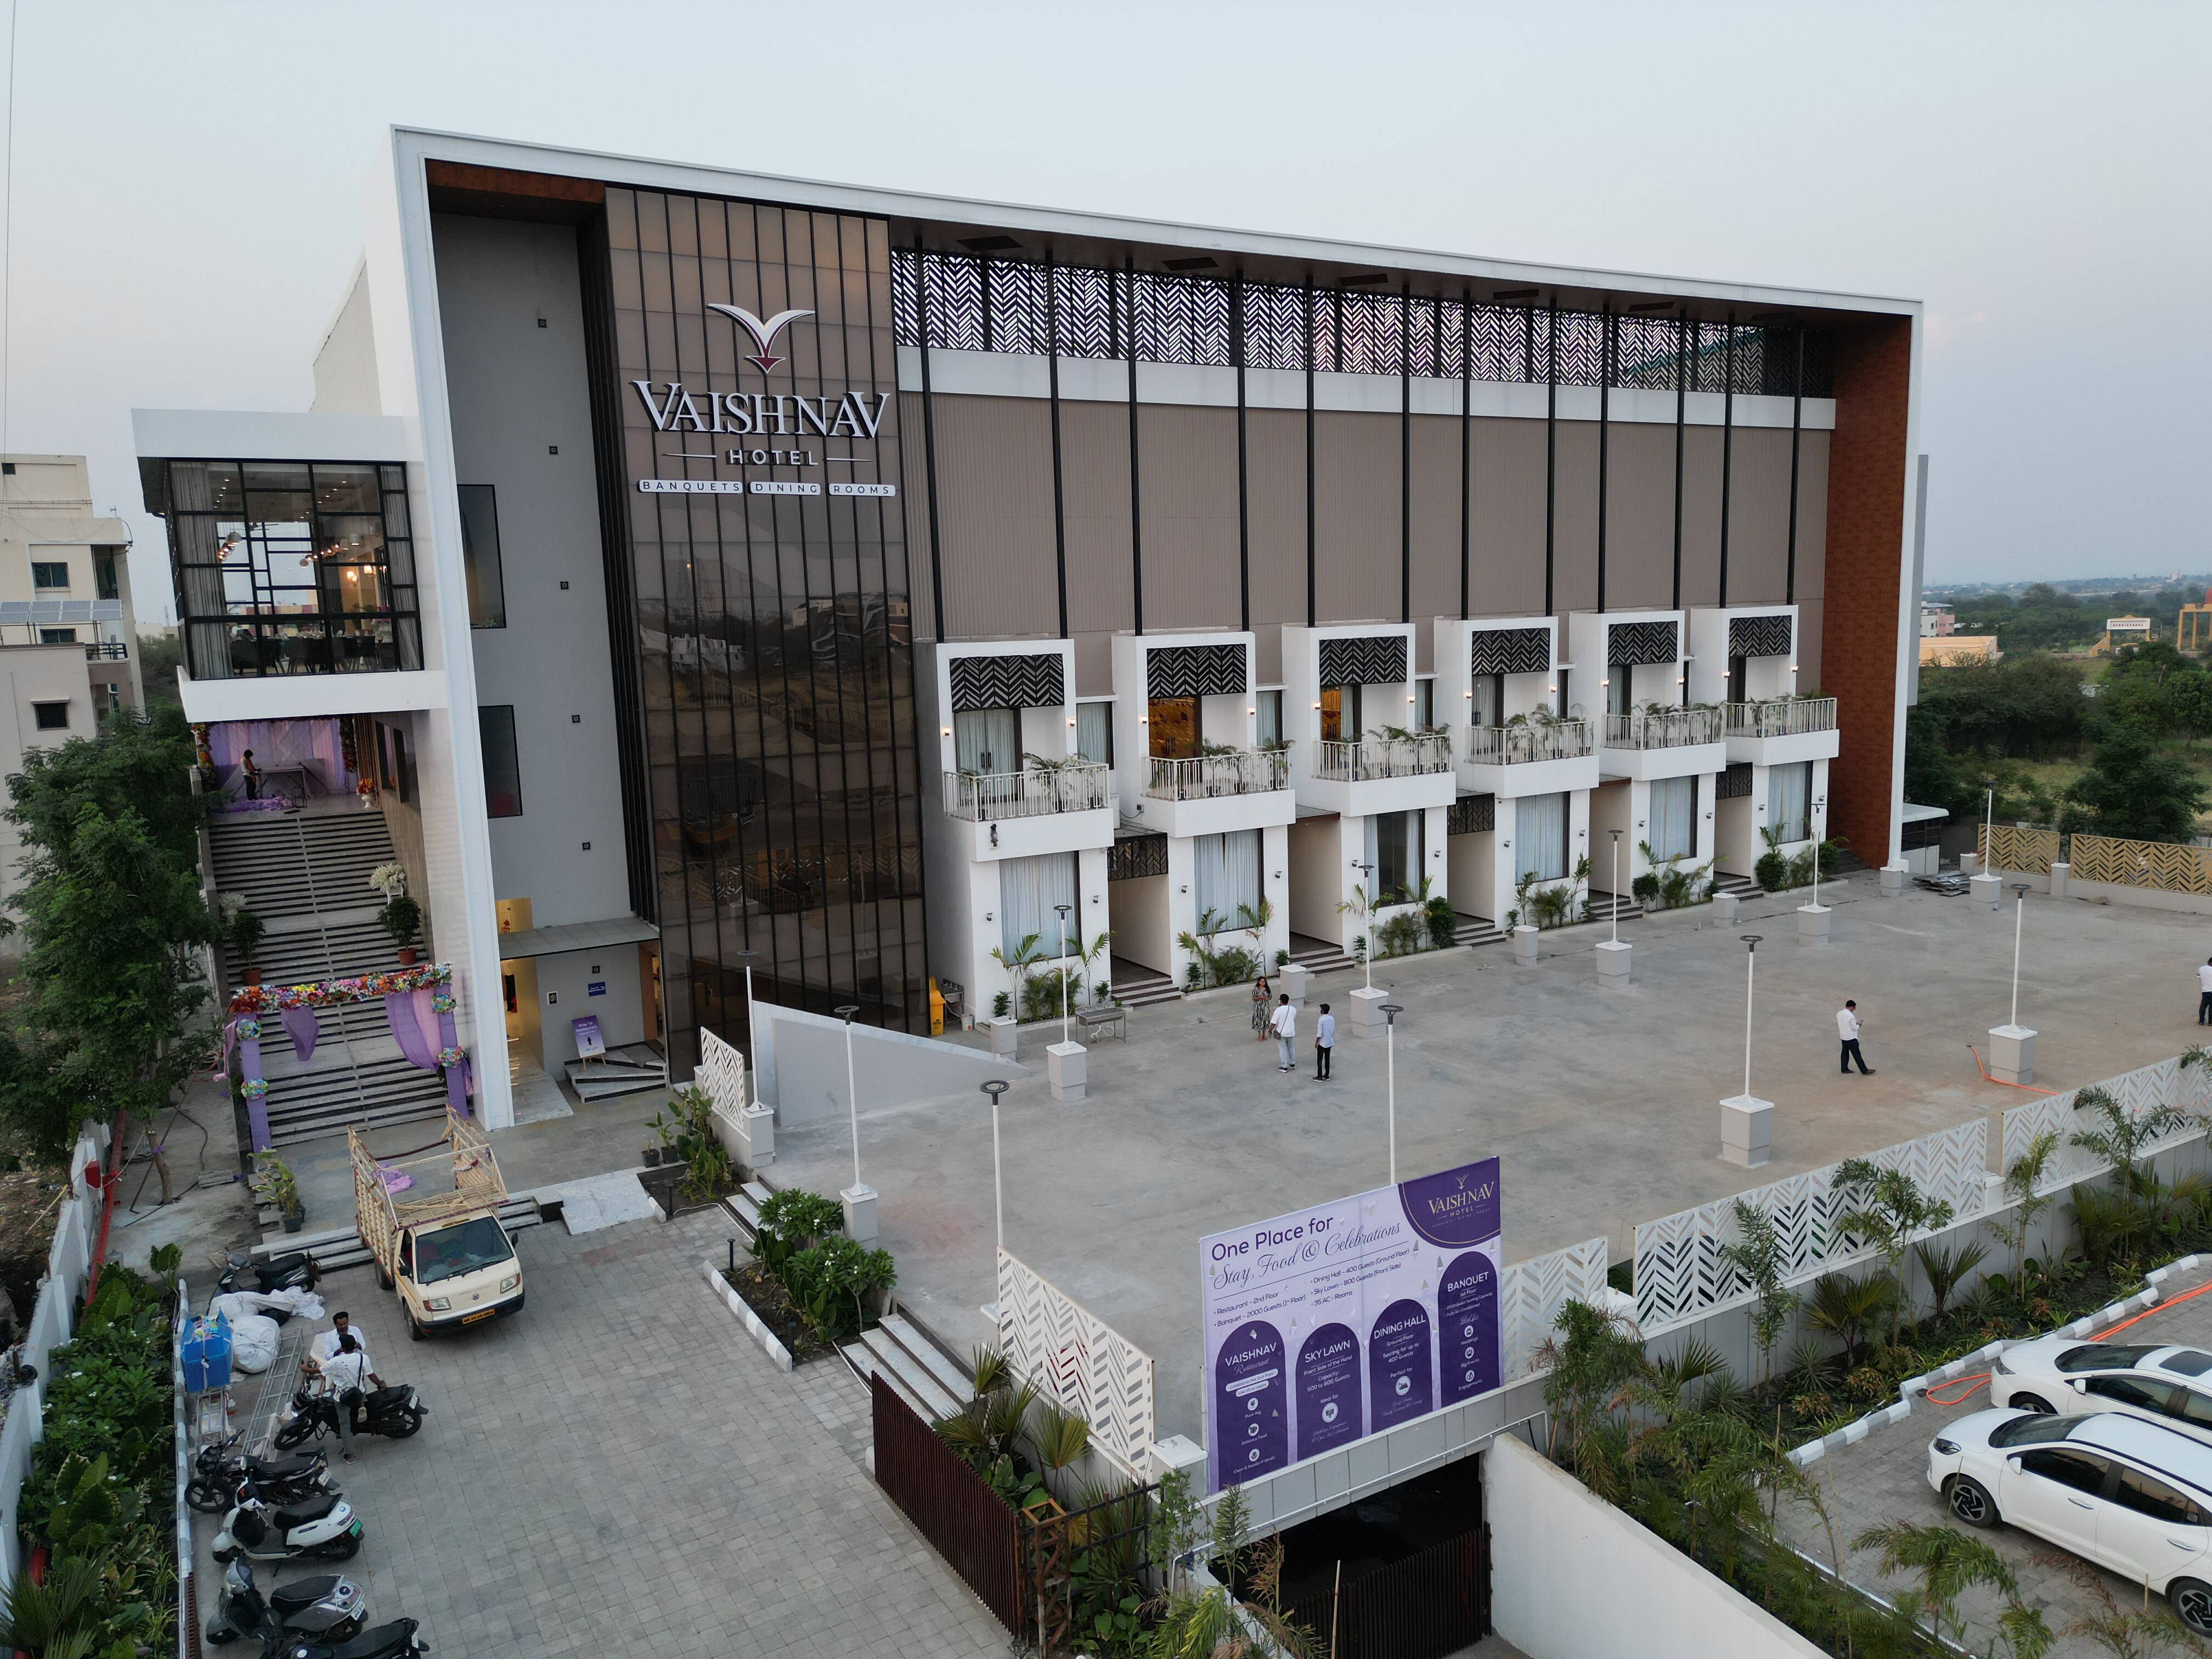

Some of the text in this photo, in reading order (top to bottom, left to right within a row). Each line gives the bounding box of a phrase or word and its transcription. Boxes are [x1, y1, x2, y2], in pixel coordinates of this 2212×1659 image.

[632, 380, 891, 438] VAISHNAV
[729, 449, 818, 465] HOTEL
[642, 482, 889, 494] BANQUETS DINING ROOMS
[1427, 1181, 1494, 1215] VAISHNAV
[1450, 1206, 1474, 1217] HOTEL
[1211, 1217, 1334, 1261] One Place for
[1214, 1264, 1255, 1289] Stay,
[1257, 1242, 1302, 1278] Food
[1325, 1223, 1401, 1256] Celebrations
[1314, 1274, 1330, 1284] Dining
[1331, 1270, 1341, 1278] Hall
[1346, 1265, 1357, 1274] 400
[1358, 1261, 1375, 1270] Guests
[1375, 1254, 1395, 1265] (Ground
[1396, 1248, 1409, 1258] Floor)
[1324, 1284, 1339, 1292] Lawn
[1356, 1272, 1373, 1282] Guests
[1374, 1267, 1389, 1277] (Front
[1389, 1262, 1401, 1271] Side)
[1448, 1271, 1489, 1293] BANQUET
[1217, 1301, 1248, 1315] Restaurant
[1253, 1295, 1265, 1304] 2nd
[1265, 1292, 1279, 1300] Floor
[1322, 1296, 1330, 1304] AC
[1335, 1290, 1353, 1300] Rooms
[1217, 1314, 1242, 1327] Banquet
[1246, 1308, 1263, 1318] 2000
[1263, 1302, 1282, 1313] Guests
[1291, 1294, 1306, 1304] Floor)
[1374, 1314, 1426, 1340] DINING HALL
[1305, 1340, 1350, 1363] SKY LAWN
[1386, 1337, 1402, 1346] Ground
[1225, 1342, 1277, 1367] VAISHNAV
[1304, 1368, 1316, 1376] Front
[1341, 1355, 1353, 1363] Hotel
[1398, 1351, 1414, 1359] Guests
